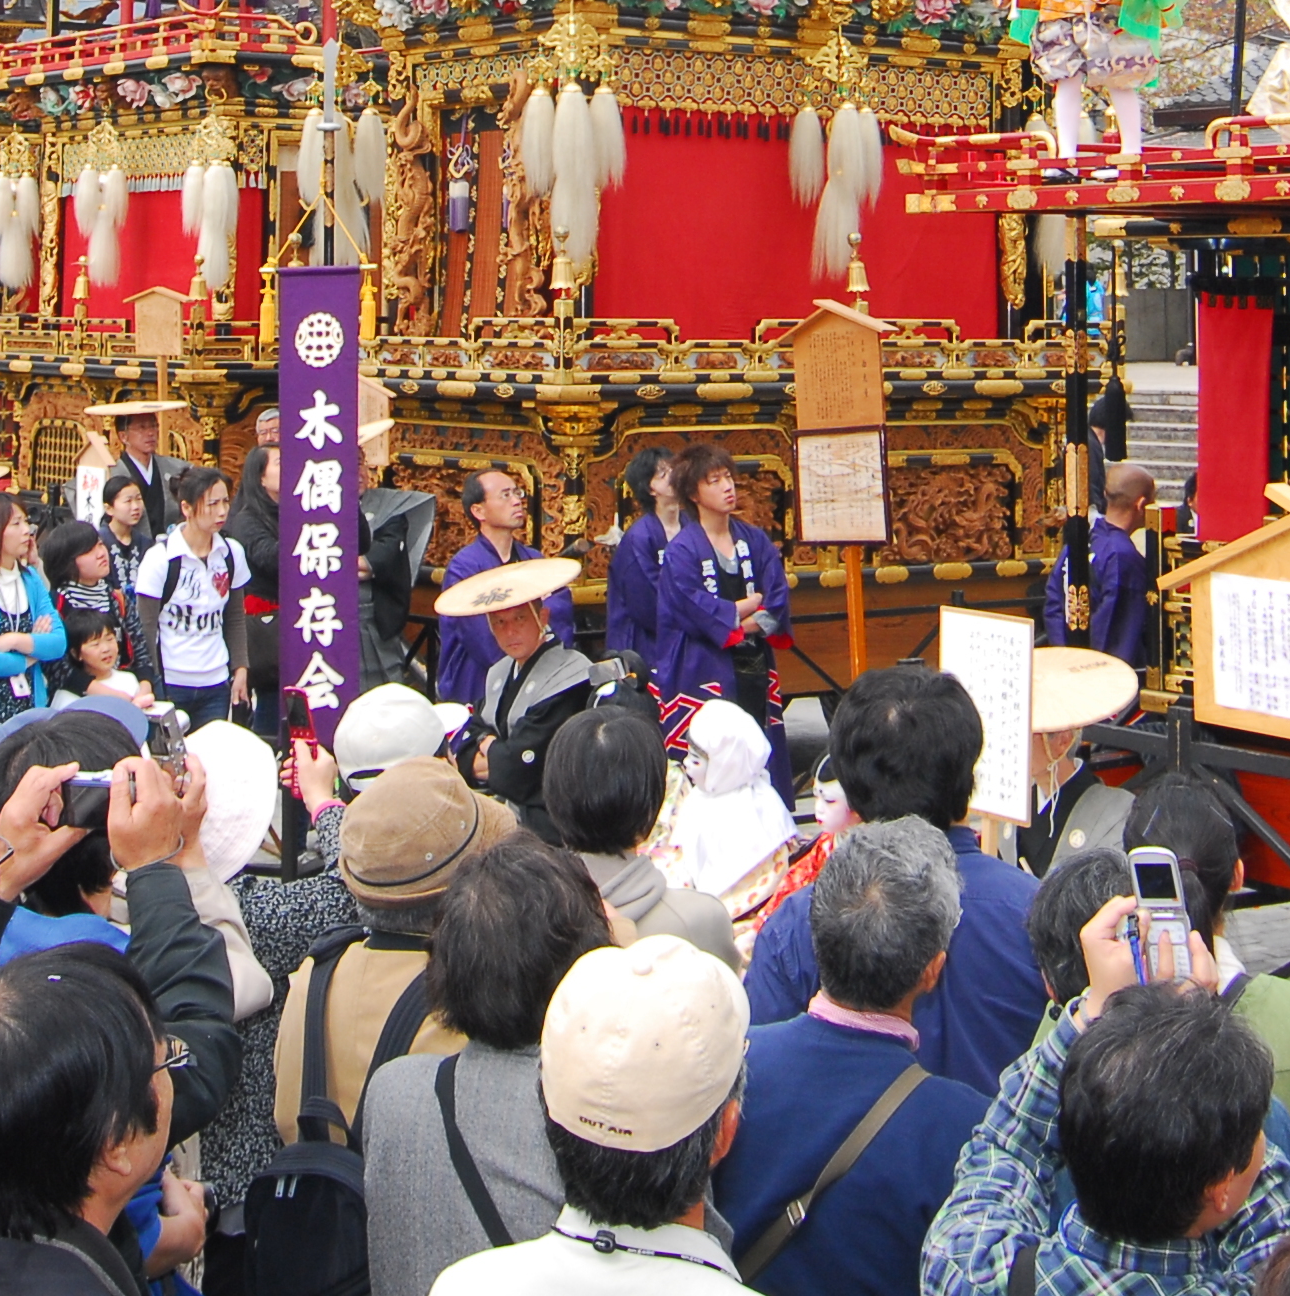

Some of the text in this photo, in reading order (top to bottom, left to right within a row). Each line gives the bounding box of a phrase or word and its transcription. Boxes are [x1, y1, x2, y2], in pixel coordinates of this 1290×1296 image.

[292, 389, 345, 710] 木偶保存会
[578, 1115, 605, 1129] OUT
